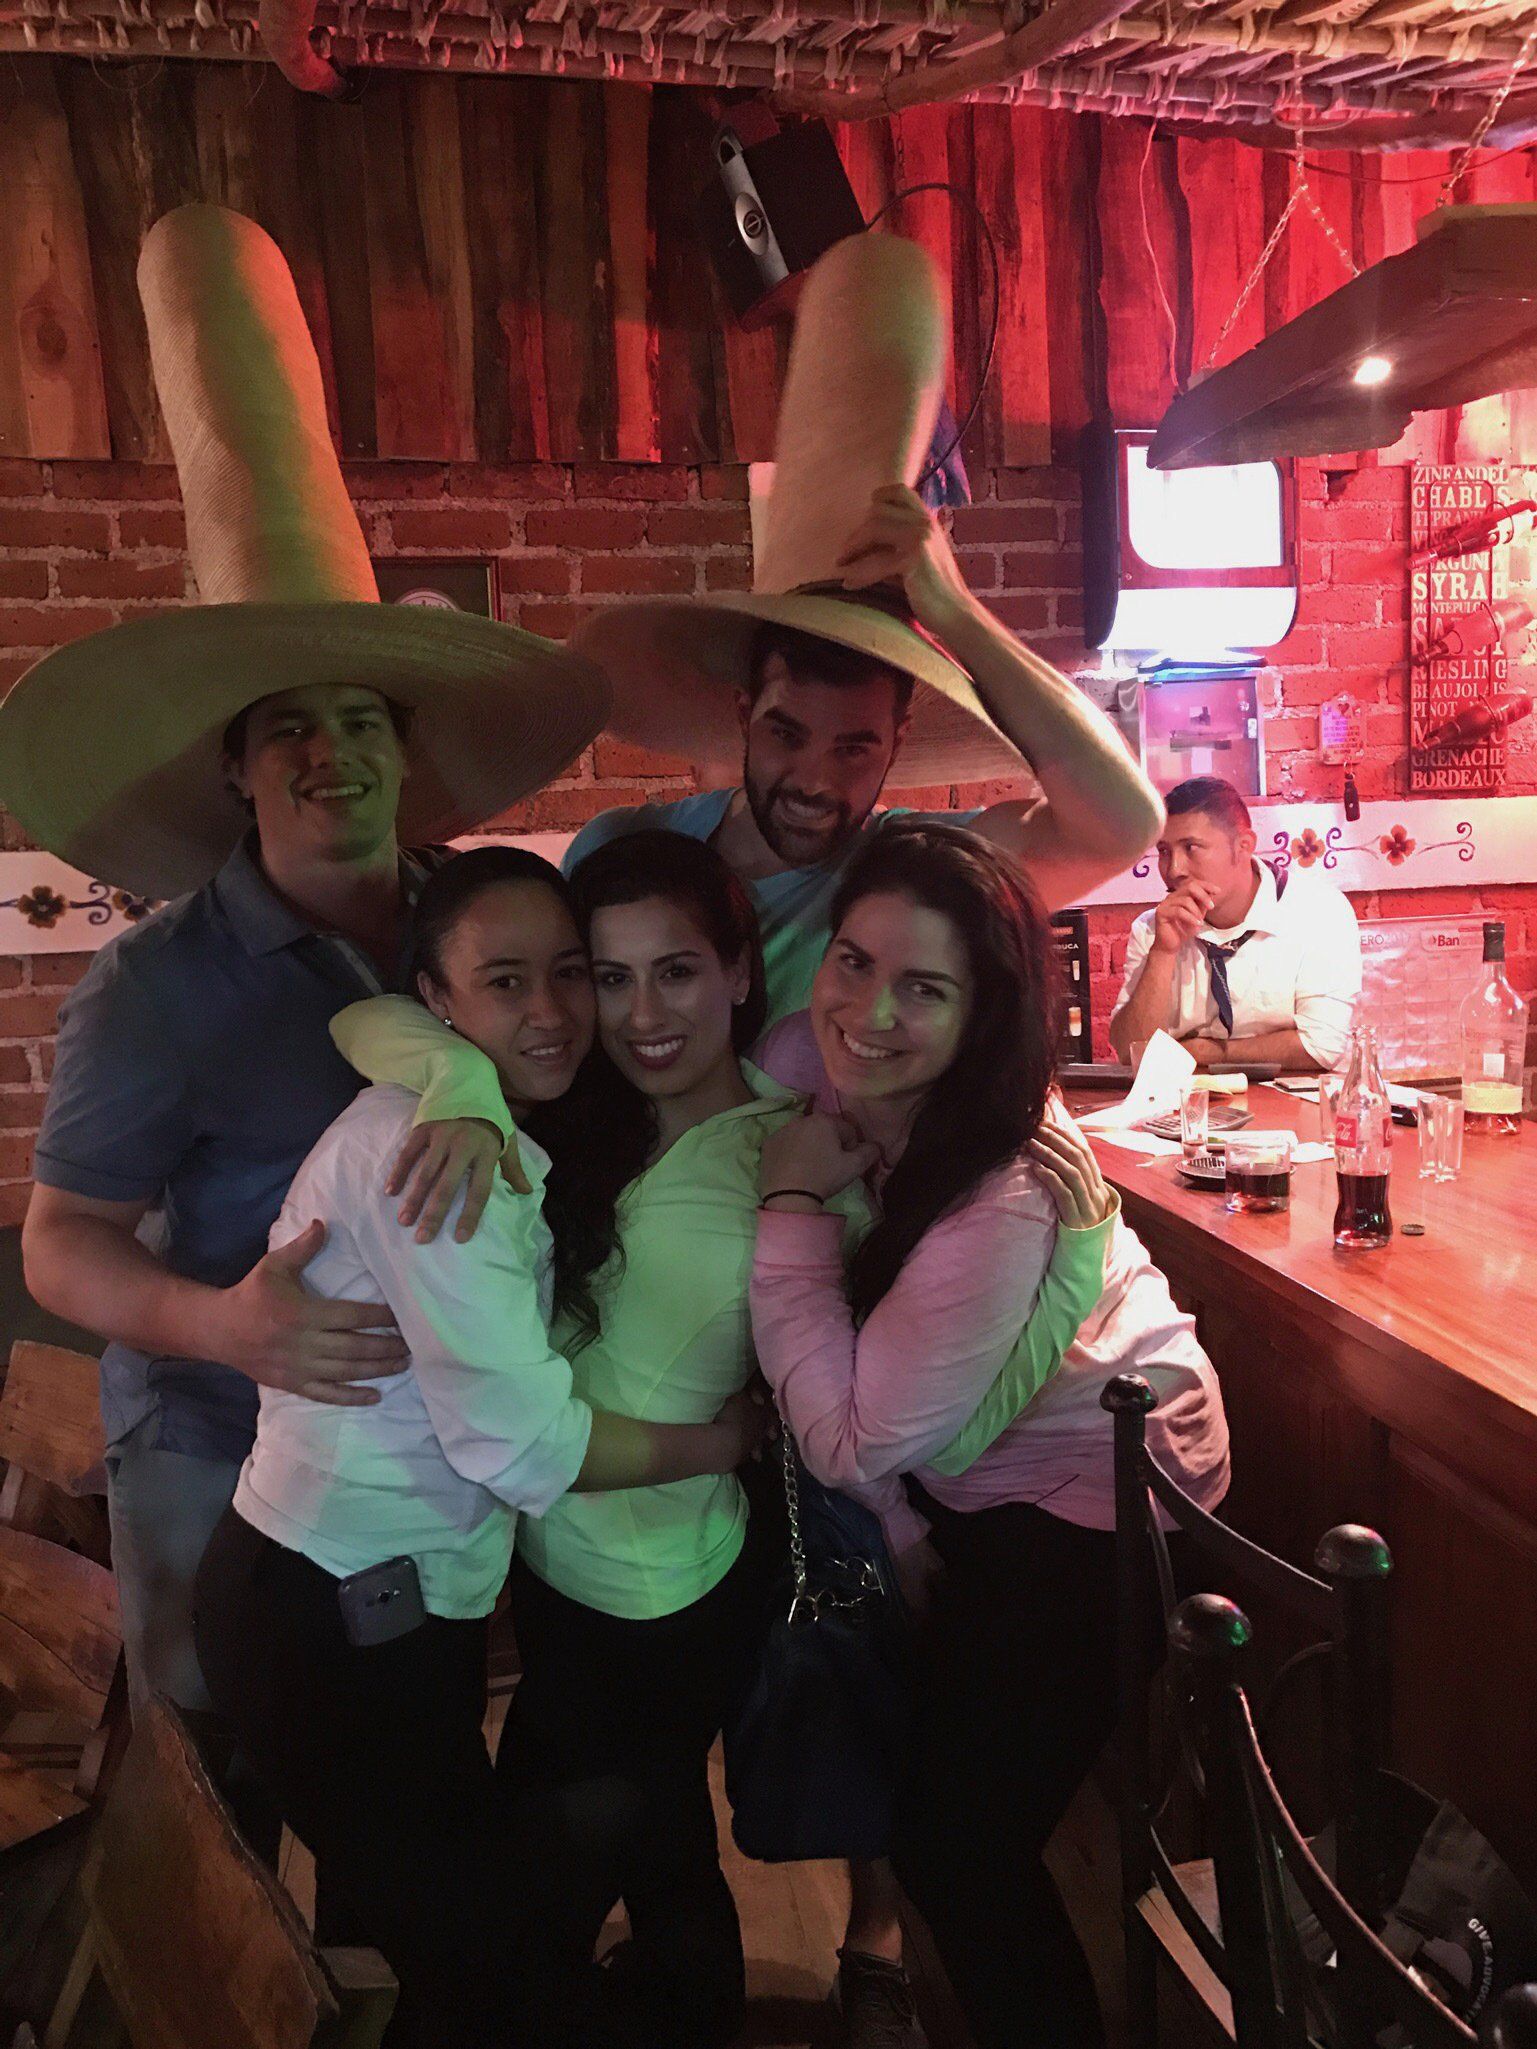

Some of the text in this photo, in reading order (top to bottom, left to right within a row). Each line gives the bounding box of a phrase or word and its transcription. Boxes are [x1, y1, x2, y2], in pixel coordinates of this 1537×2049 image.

[1412, 466, 1508, 485] ZINFANDEL
[1412, 485, 1511, 509] CHABLS
[1412, 572, 1508, 600] SYRAH
[1412, 701, 1458, 718] PINOT
[1411, 748, 1507, 767] GRENACHE
[1412, 769, 1508, 788] BORDEAUX
